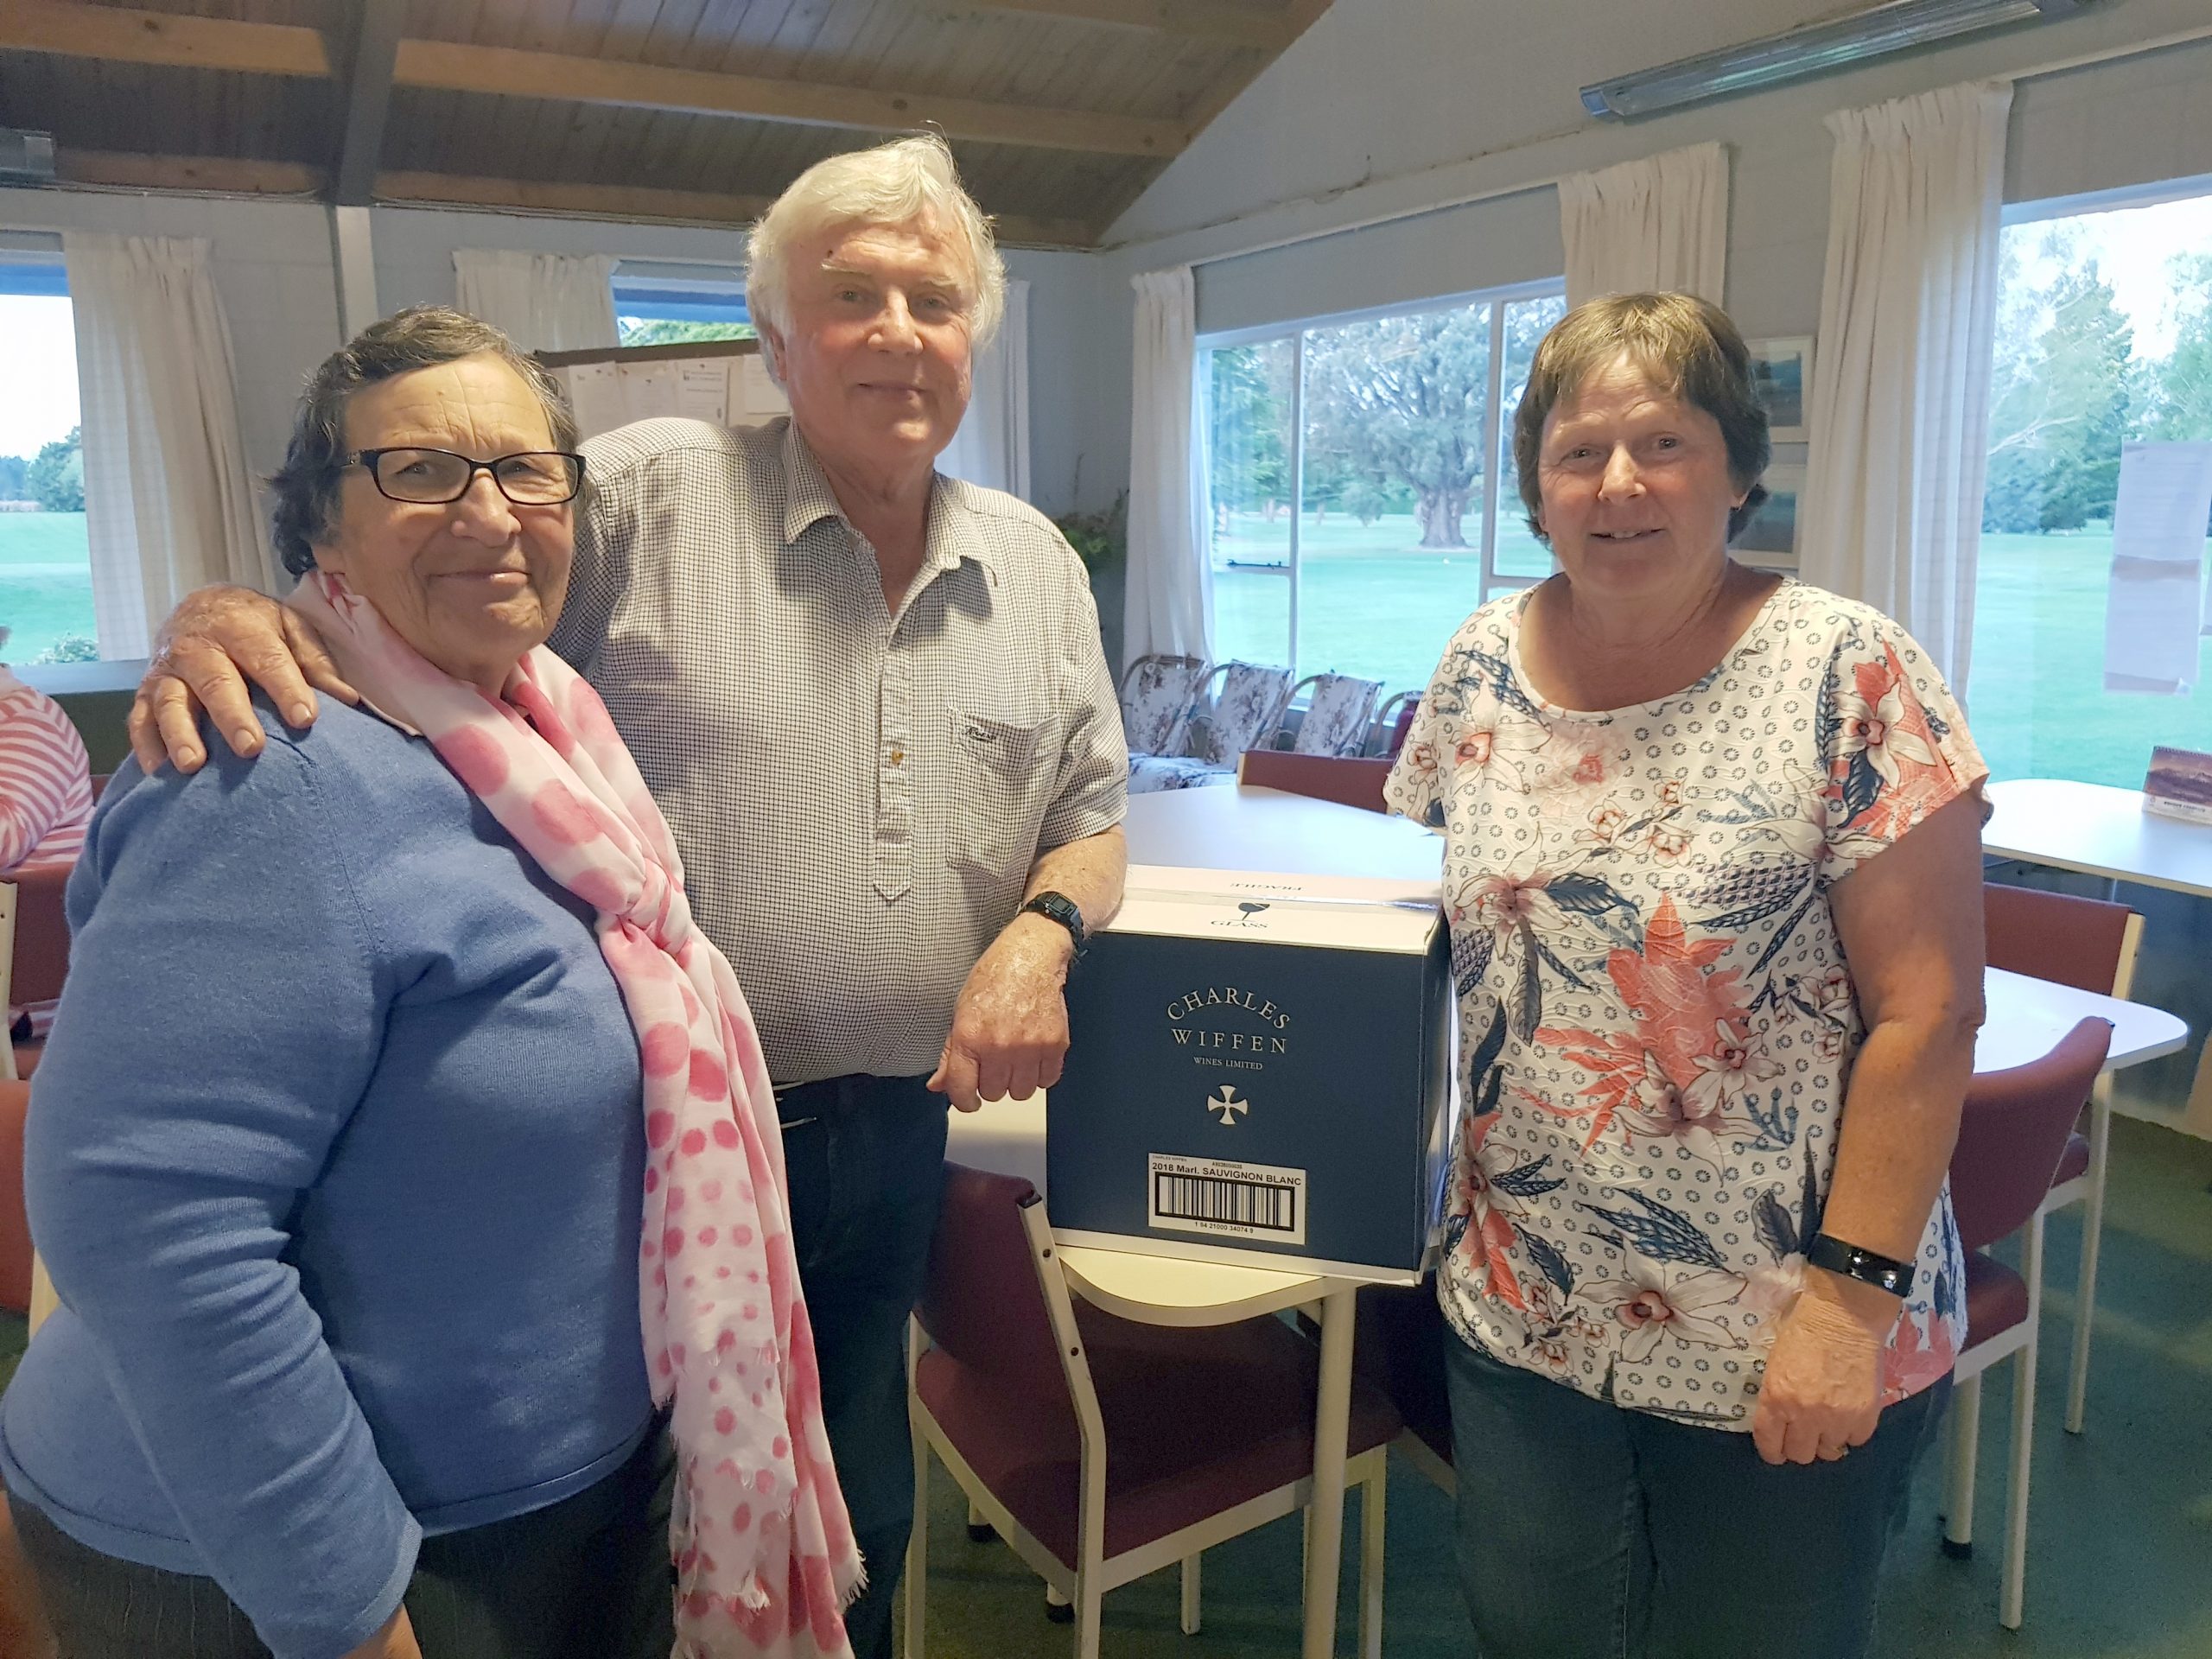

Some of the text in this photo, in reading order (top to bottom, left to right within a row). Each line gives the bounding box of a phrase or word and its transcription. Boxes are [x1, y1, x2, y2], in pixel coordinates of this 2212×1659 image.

[1211, 919, 1268, 929] GLASS
[1167, 987, 1291, 1029] CHARLES
[1171, 1028, 1287, 1054] WIFFEN
[1193, 1056, 1263, 1071] WINES LIMITED
[1152, 1162, 1302, 1185] 2018 Marl. SAUVIGNON BLANC
